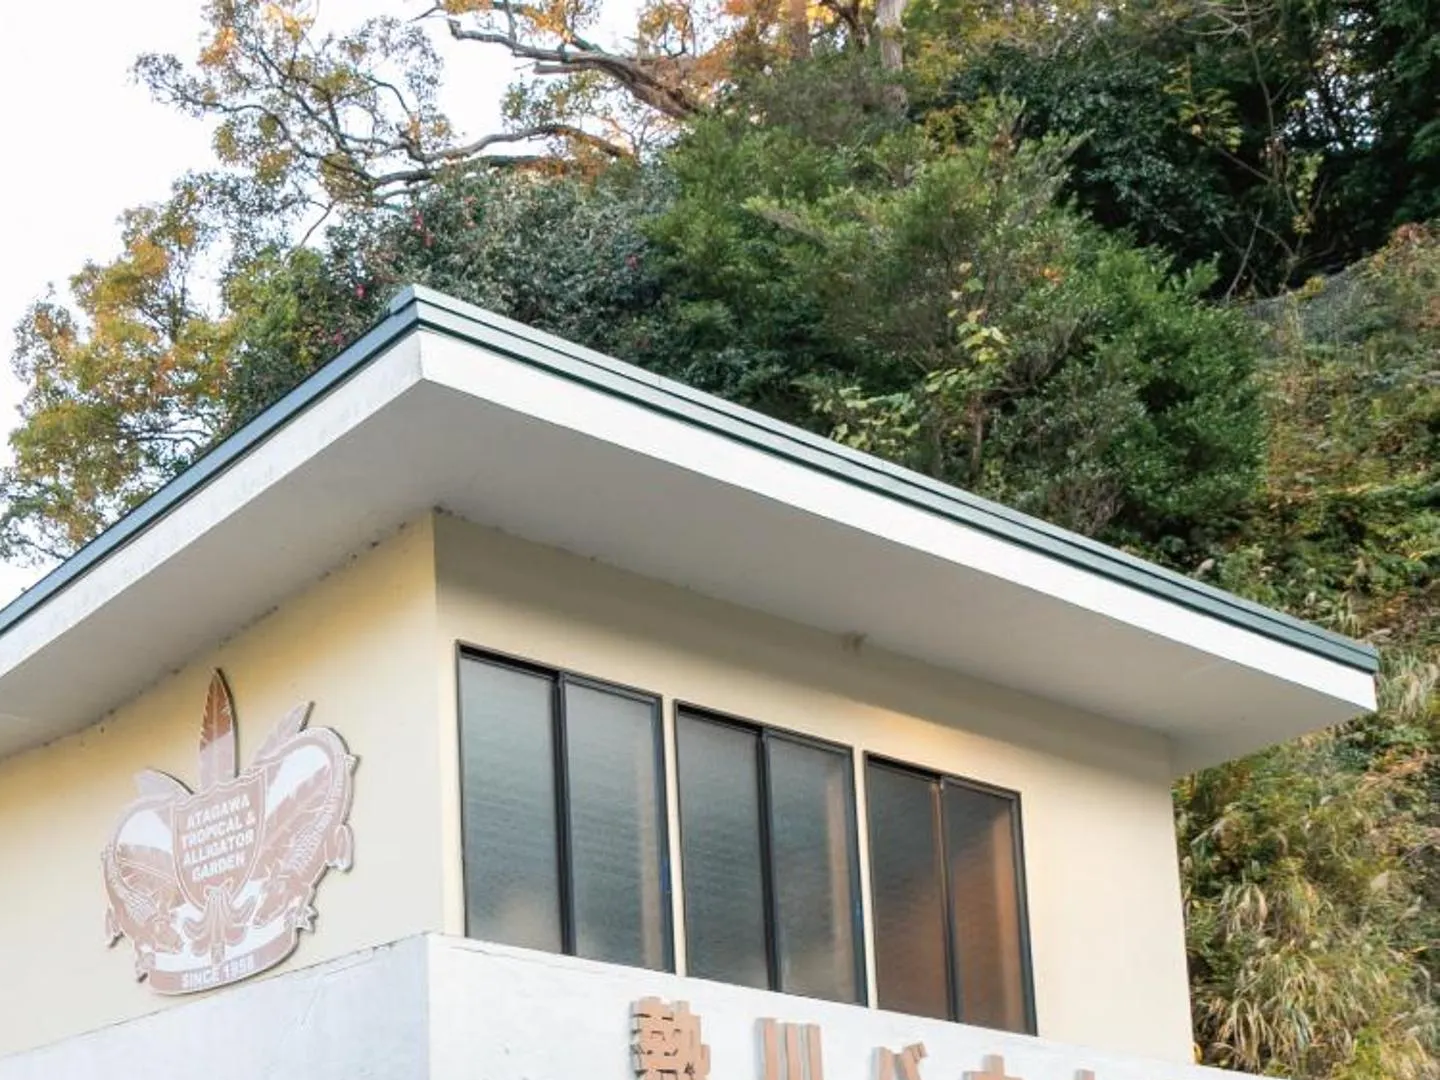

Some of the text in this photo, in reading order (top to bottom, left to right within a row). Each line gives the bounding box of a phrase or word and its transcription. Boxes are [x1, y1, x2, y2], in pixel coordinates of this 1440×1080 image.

[187, 794, 250, 829] ATAGAWA
[182, 815, 243, 851] TROPICAL
[183, 828, 254, 865] ALLIGATOR
[191, 851, 245, 882] GARDEN
[181, 966, 220, 989] SINCE
